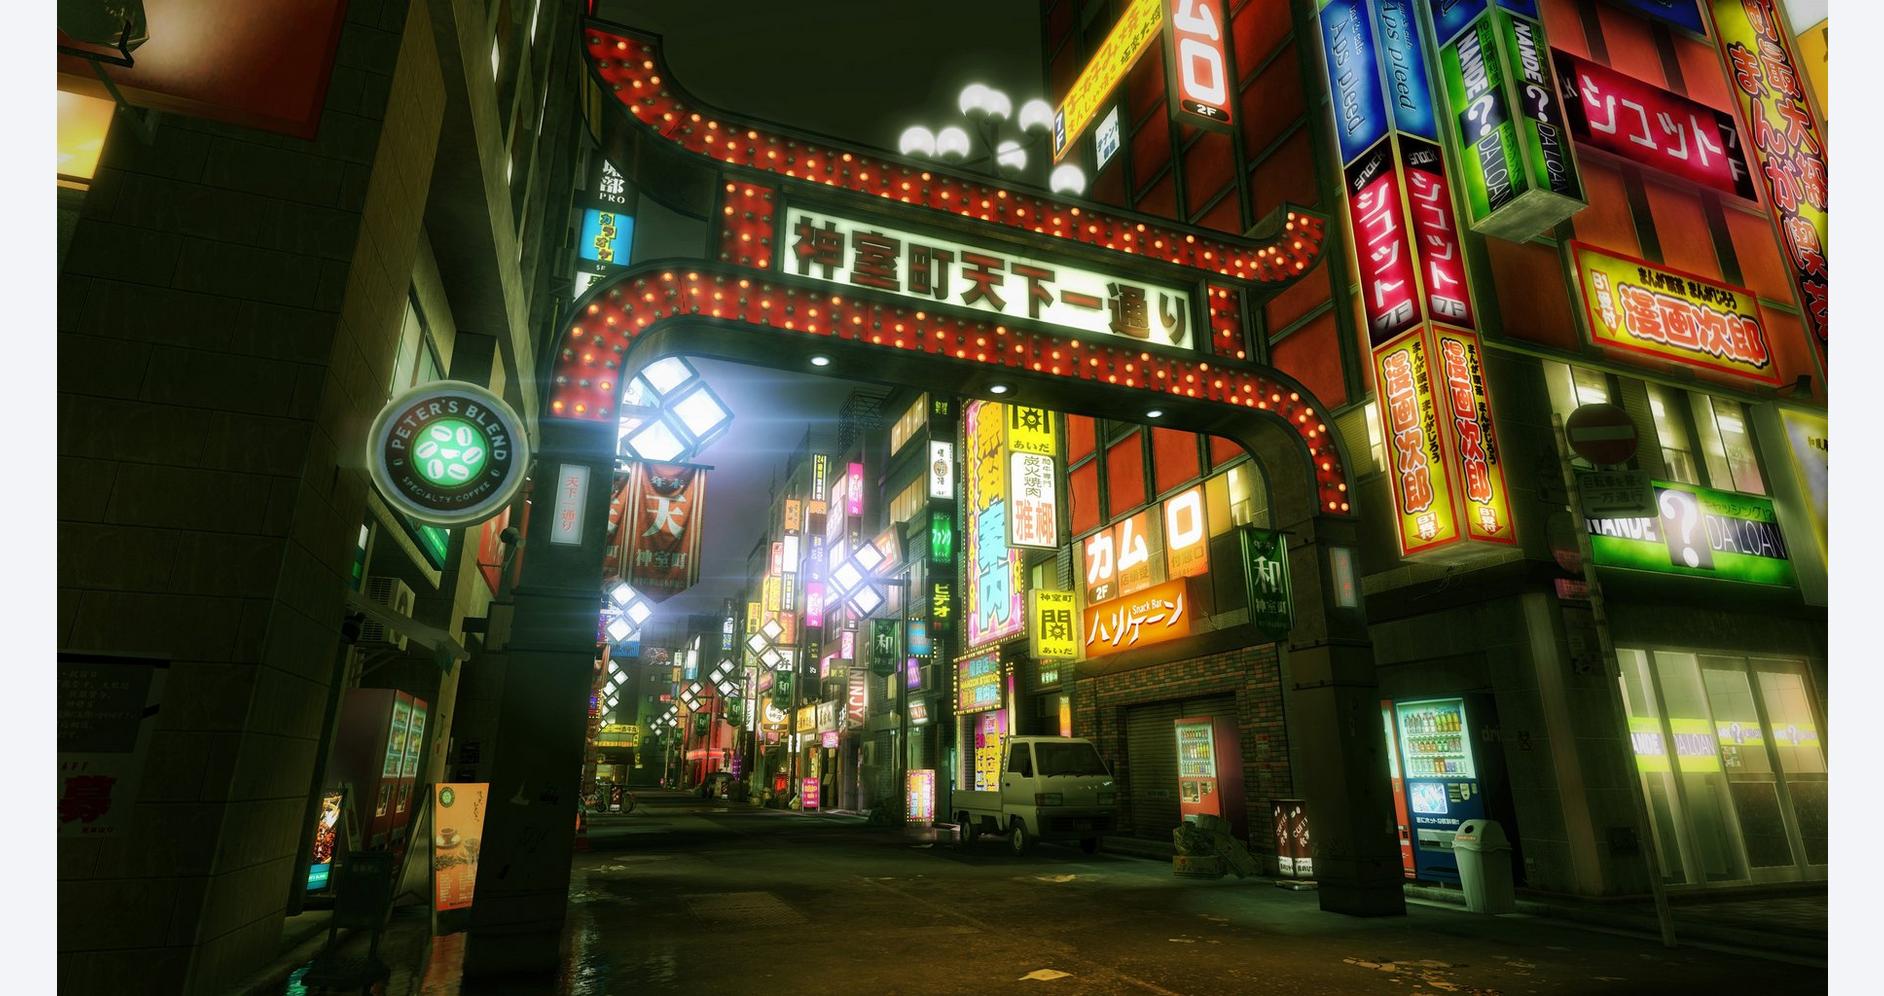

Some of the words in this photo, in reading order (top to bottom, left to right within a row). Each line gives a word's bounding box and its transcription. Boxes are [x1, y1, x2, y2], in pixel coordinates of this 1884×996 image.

[1330, 19, 1349, 68] Aps
[1456, 28, 1488, 102] NANDE
[1512, 19, 1543, 84] NANDE
[1339, 68, 1366, 137] pleed
[1388, 49, 1416, 112] pleed
[1197, 104, 1216, 116] 2F
[1477, 130, 1503, 165] DA
[1536, 122, 1558, 149] DA
[600, 192, 626, 204] PRO
[1483, 156, 1513, 211] LOAN
[792, 216, 1188, 345] 神室町天下一通り
[1377, 301, 1411, 331] 7F
[1437, 297, 1464, 317] 7F
[1616, 281, 1771, 370] 漫画次郎
[391, 400, 459, 450] PETER'S
[465, 404, 507, 461] BLEND
[1383, 349, 1434, 514] 漫画次郎
[1441, 337, 1492, 504] 漫画次郎
[1013, 439, 1051, 453] あいだ
[402, 476, 450, 503] SPECIALTY
[456, 481, 491, 503] COFFEE
[641, 494, 687, 540] 天
[1705, 514, 1738, 553] DA
[1735, 518, 1786, 559] LOAN
[1096, 585, 1109, 601] 2F
[1253, 555, 1284, 594] 和
[1040, 593, 1074, 602] 神室町
[1087, 592, 1184, 646] ハリケーン
[1132, 600, 1150, 615] Snack
[1042, 647, 1074, 656] あいだ
